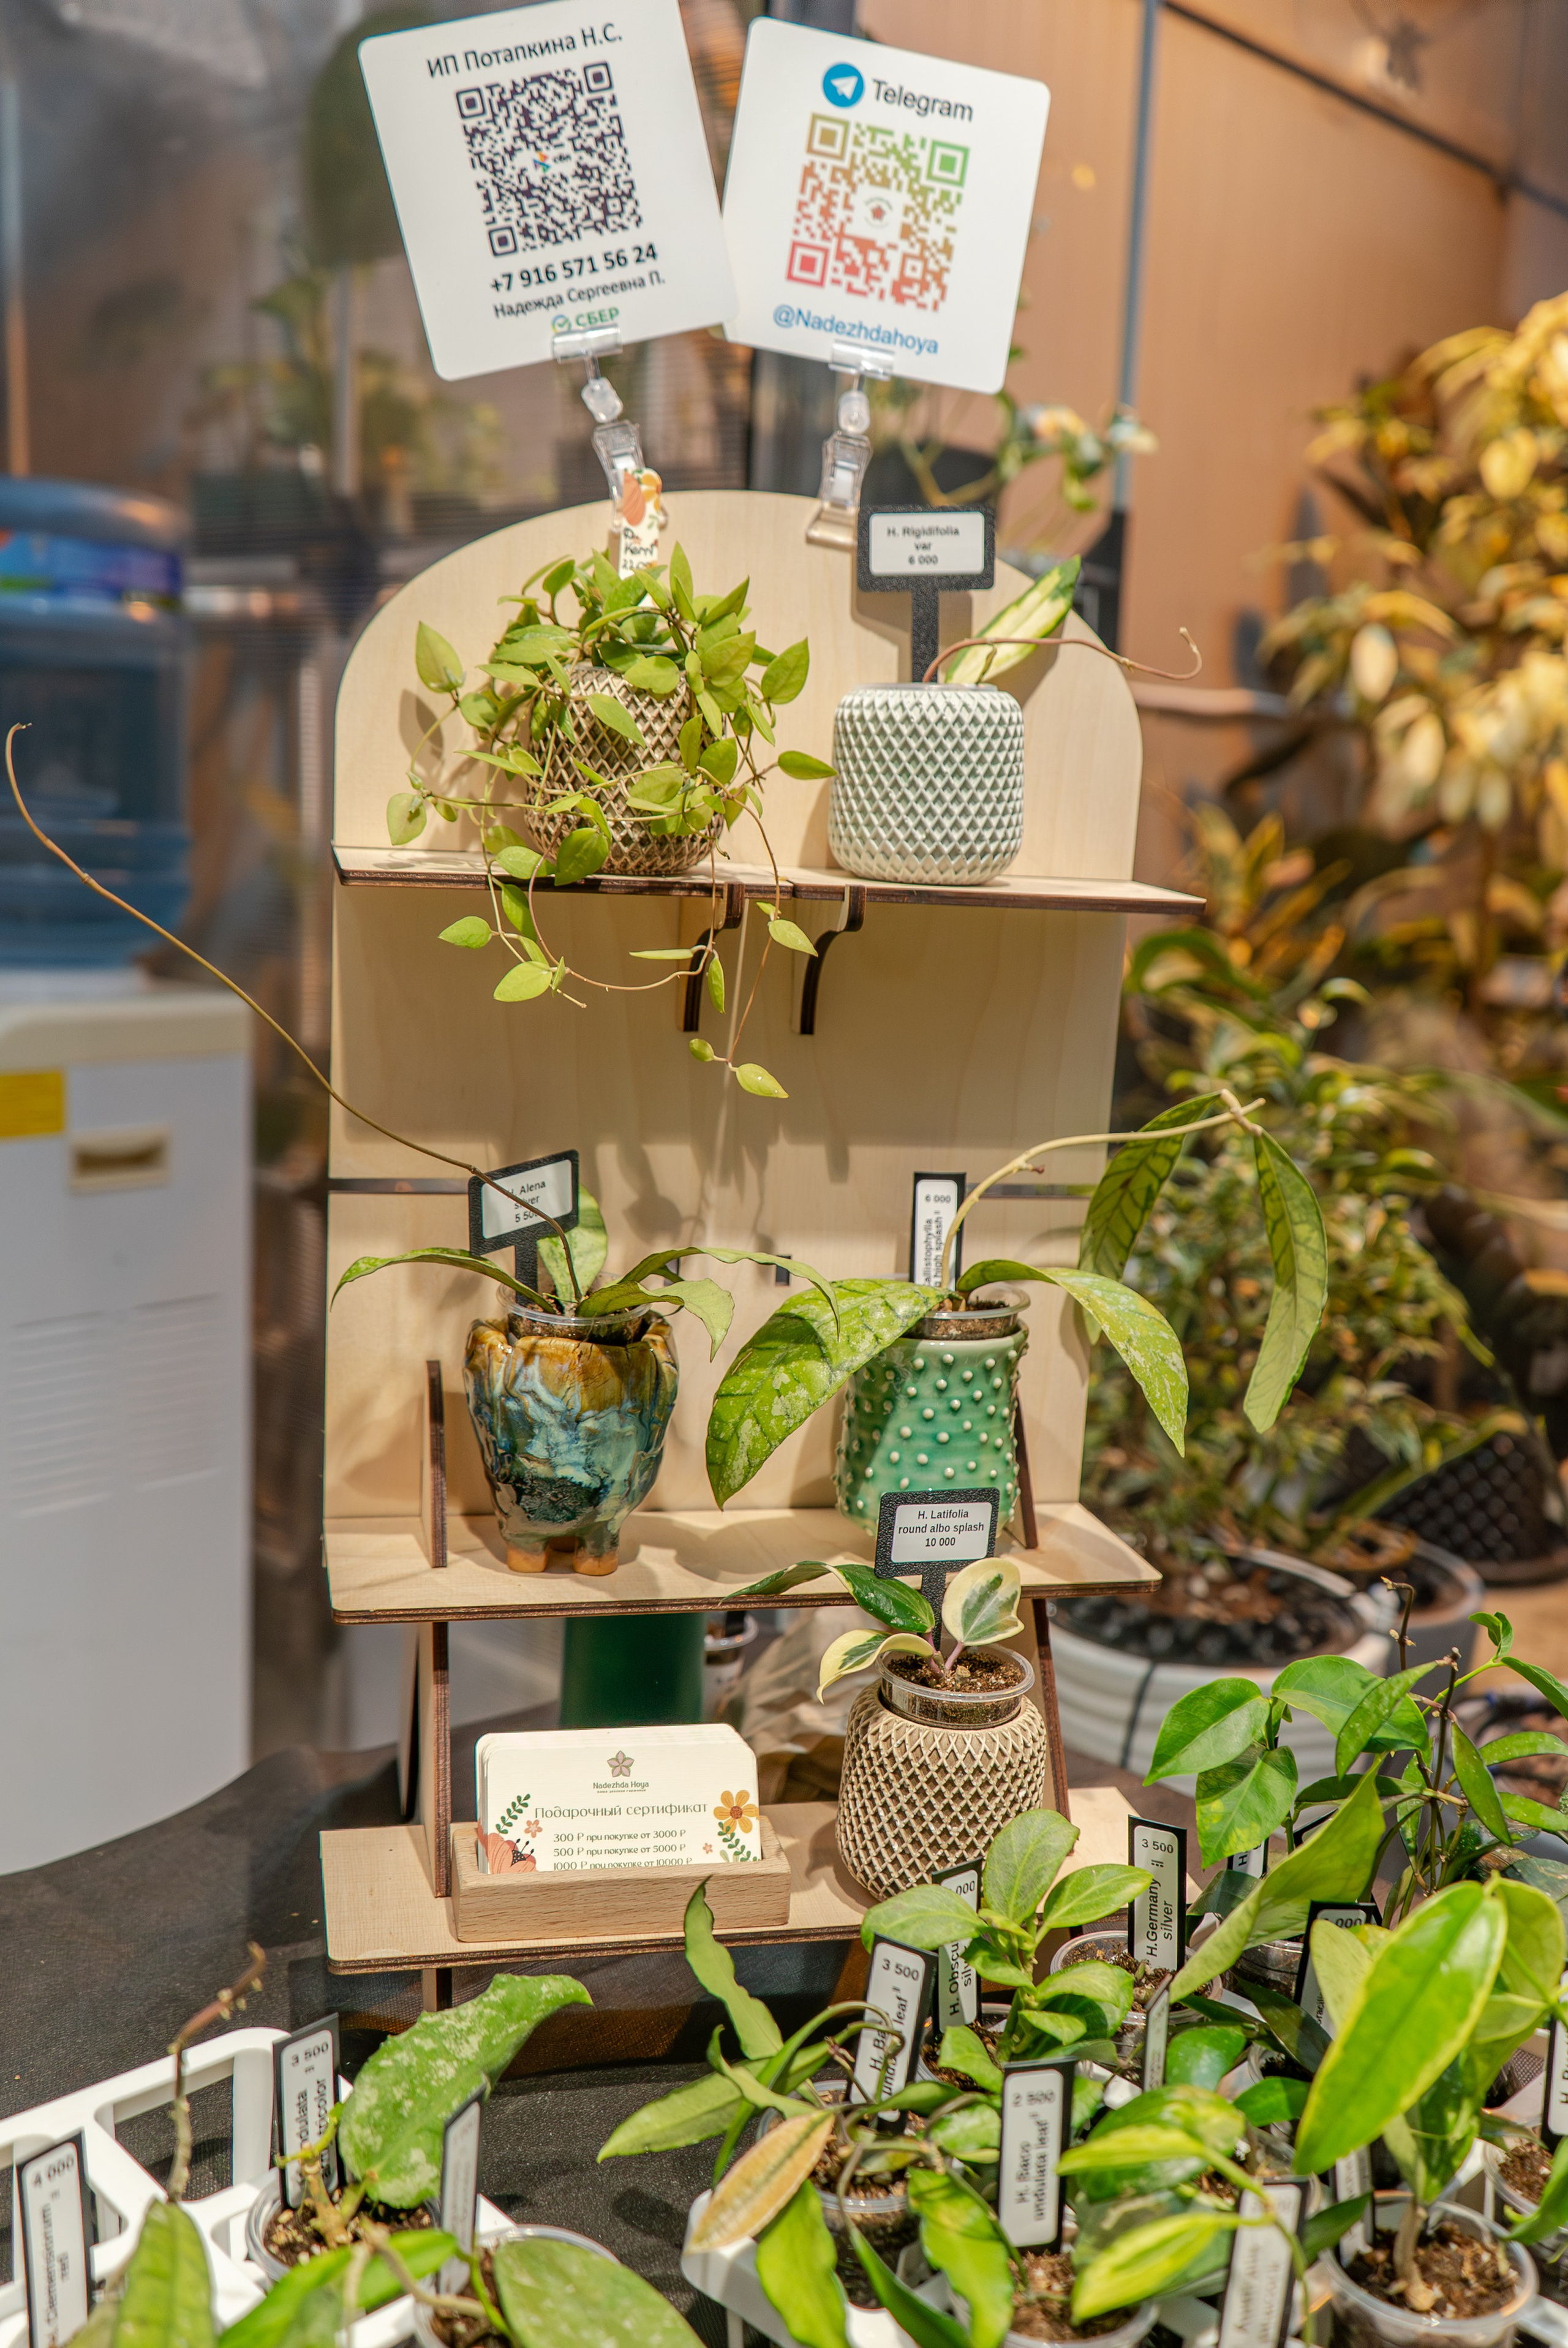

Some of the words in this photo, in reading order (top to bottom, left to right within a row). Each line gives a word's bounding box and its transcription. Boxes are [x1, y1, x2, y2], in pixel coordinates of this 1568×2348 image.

[428, 55, 459, 78] ИП
[466, 38, 576, 71] Потапкина
[581, 22, 623, 48] Н.С.
[873, 78, 973, 121] Telegram
[491, 272, 513, 292] +7
[521, 265, 557, 288] 916
[562, 255, 600, 279] 571
[603, 249, 628, 270] 56
[633, 243, 658, 264] 24
[493, 293, 564, 319] Надежда
[567, 276, 646, 303] Сергеевна
[649, 270, 666, 285] П.
[575, 306, 620, 328] СБЕР
[773, 303, 939, 355] @Nadezhdahoya
[887, 526, 899, 537] H.
[918, 554, 938, 565] 000
[519, 1181, 546, 1195] Alena
[934, 1194, 951, 1203] 000
[515, 1214, 521, 1223] 5
[524, 1211, 538, 1220] 50
[918, 1511, 927, 1520] H.
[931, 1509, 969, 1519] Latifolia
[898, 1524, 927, 1535] round
[930, 1523, 950, 1533] albo
[953, 1522, 984, 1535] splash
[925, 1538, 937, 1547] 10
[939, 1537, 956, 1547] 000
[631, 1781, 649, 1789] Hoya
[535, 1805, 622, 1820] Подарочный
[626, 1803, 708, 1818] сертификат
[553, 1833, 574, 1843] 300
[586, 1835, 603, 1843] при
[605, 1833, 638, 1842] покупке
[653, 1830, 677, 1839] 3000
[553, 1848, 574, 1857] 500
[586, 1849, 603, 1857] при
[605, 1847, 638, 1857] покупке
[653, 1844, 677, 1853] 5000
[1142, 1838, 1148, 1848] 3
[1153, 1841, 1174, 1854] 500
[554, 1862, 577, 1871] 1000
[656, 1858, 684, 1867] 10000
[1146, 1878, 1161, 1957] H.Germany
[1160, 1900, 1174, 1941] silver
[882, 1958, 891, 1971] 3
[895, 1962, 919, 1982] 500
[948, 1942, 960, 1994] Obscu
[892, 1995, 909, 2025] leaf
[949, 1998, 960, 2015] H.
[290, 2053, 300, 2067] 3
[304, 2041, 329, 2059] 500
